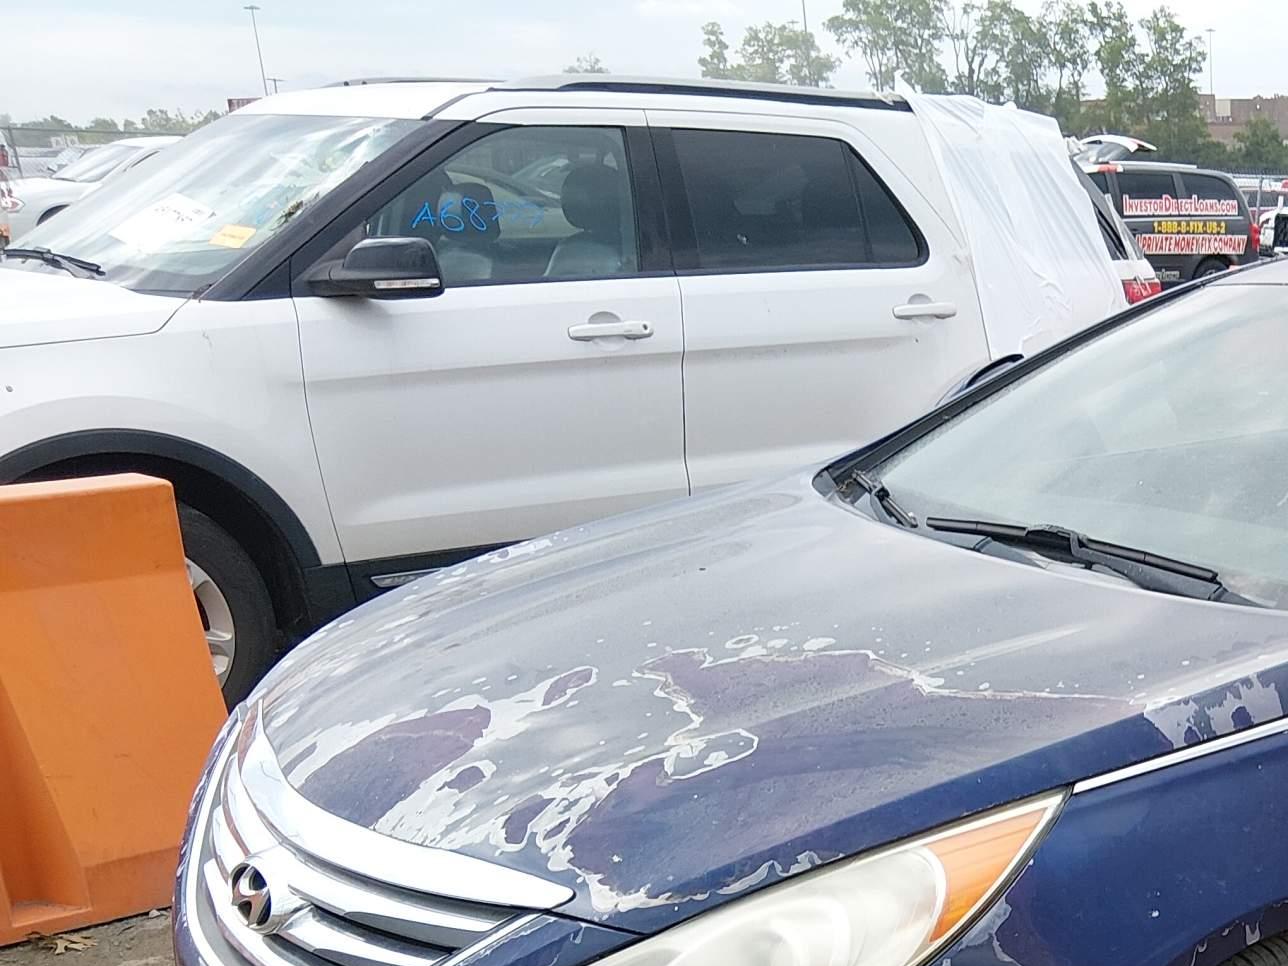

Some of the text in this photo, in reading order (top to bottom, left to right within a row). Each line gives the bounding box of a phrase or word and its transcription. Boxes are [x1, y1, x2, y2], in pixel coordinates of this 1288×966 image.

[1142, 235, 1174, 254] PRIVATE
[1174, 235, 1200, 254] MONEY
[1200, 235, 1212, 254] FIX
[1212, 235, 1248, 254] COMPANY
